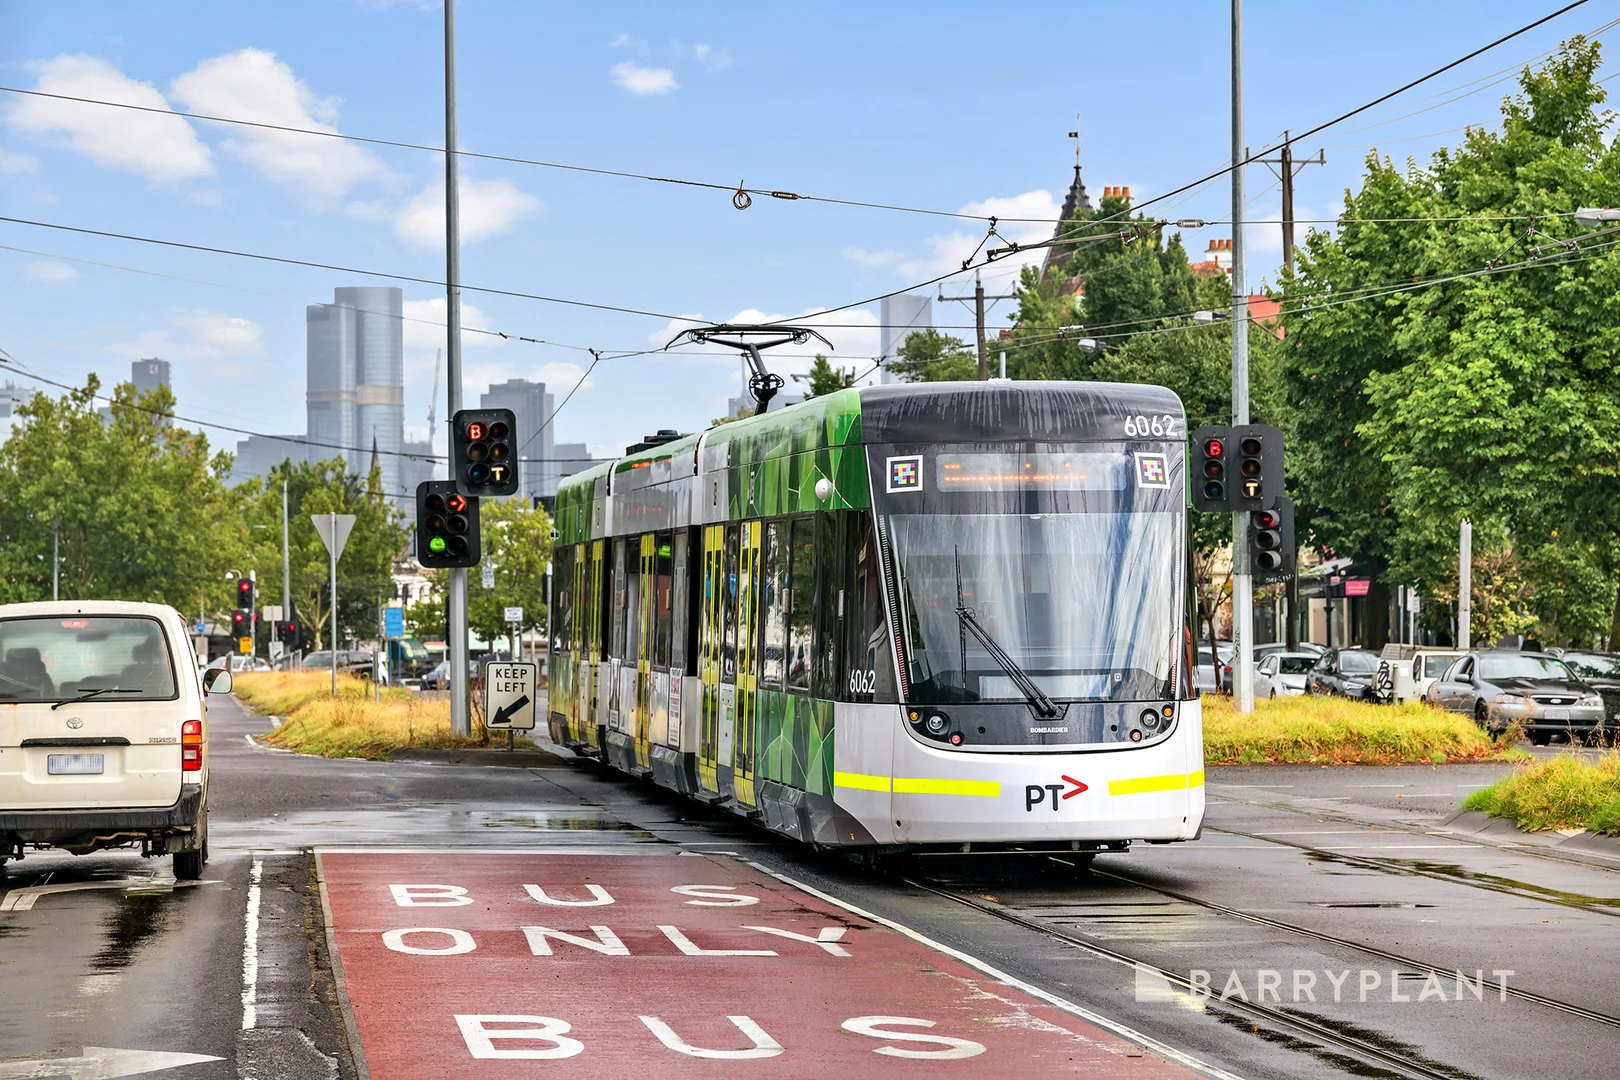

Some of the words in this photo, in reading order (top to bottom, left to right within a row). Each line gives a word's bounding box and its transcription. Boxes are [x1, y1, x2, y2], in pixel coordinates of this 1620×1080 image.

[471, 424, 481, 440] B
[1124, 414, 1178, 437] 6062
[1209, 441, 1221, 457] B
[491, 467, 504, 481] T
[1245, 482, 1259, 497] T
[496, 669, 528, 678] KEEP
[849, 669, 876, 693] 6062
[497, 682, 526, 692] LEFT
[389, 884, 760, 907] BUS
[381, 925, 853, 957] ONLY
[453, 1014, 987, 1060] BUS
